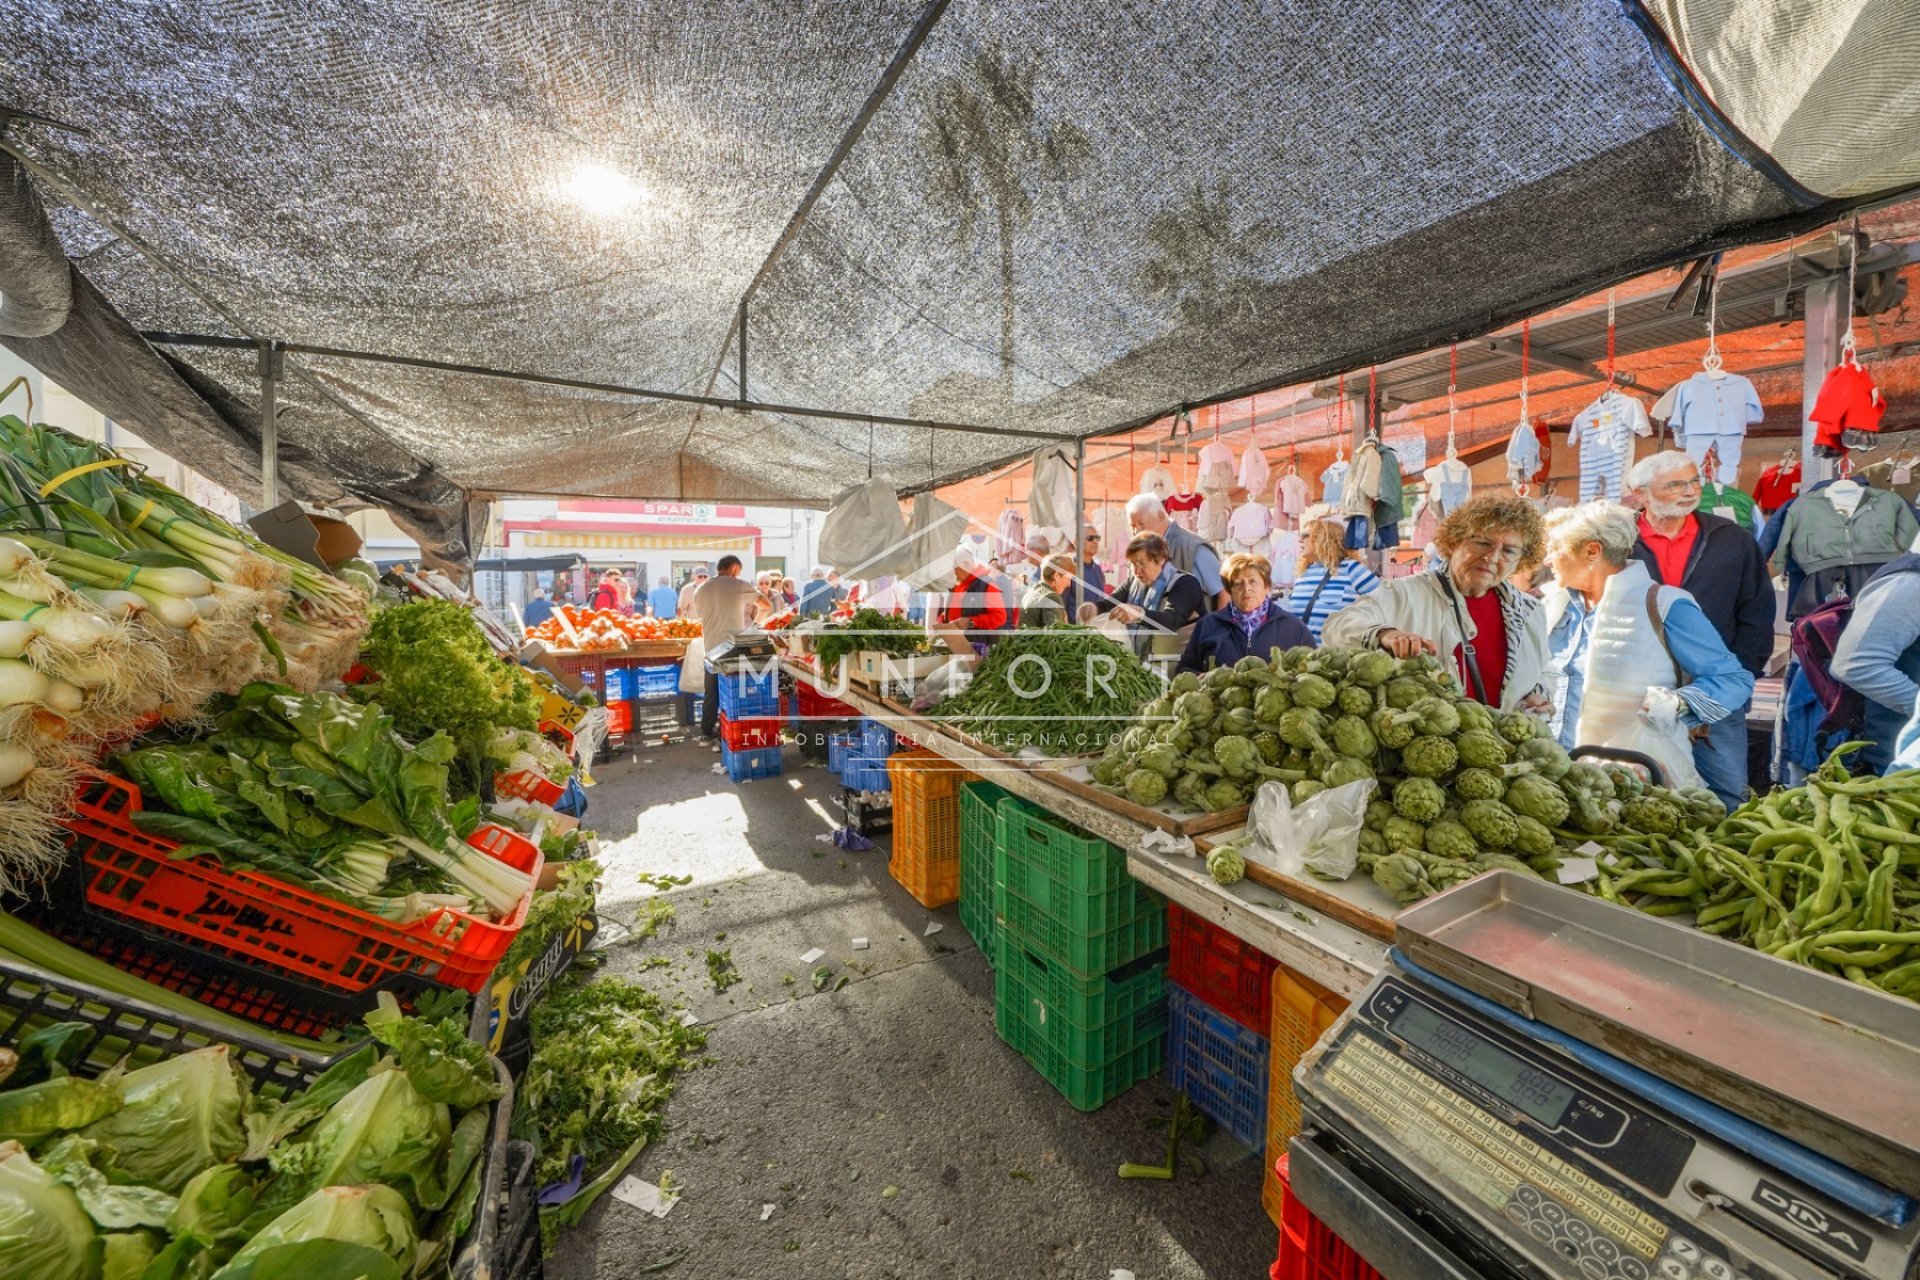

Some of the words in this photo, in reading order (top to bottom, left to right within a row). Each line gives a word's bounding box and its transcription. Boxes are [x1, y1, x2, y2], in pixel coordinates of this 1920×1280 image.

[643, 504, 692, 515] SPAR
[1357, 1095, 1371, 1108] 420
[1373, 1106, 1388, 1119] 430
[1352, 1070, 1366, 1082] 310
[1366, 1081, 1381, 1094] 320
[1383, 1092, 1398, 1105] 330
[1419, 1117, 1434, 1129] 350
[1455, 1141, 1473, 1157] 370
[1476, 1155, 1494, 1171] 380
[1496, 1171, 1515, 1187] 390
[1373, 1046, 1384, 1056] 65
[1389, 1056, 1399, 1065] 75
[1405, 1067, 1417, 1076] 85
[1441, 1088, 1453, 1099] 50
[1459, 1100, 1472, 1111] 60
[1479, 1113, 1492, 1124] 70
[1499, 1126, 1513, 1137] 80
[1521, 1140, 1534, 1151] 90
[1565, 1168, 1584, 1183] 110
[1589, 1183, 1610, 1199] 120
[1615, 1200, 1636, 1217] 130
[1643, 1217, 1664, 1235] 140
[1446, 1115, 1463, 1128] 210
[1466, 1127, 1483, 1140] 220
[1486, 1140, 1504, 1155] 230
[1508, 1155, 1526, 1170] 240
[1530, 1169, 1549, 1185] 250
[1552, 1184, 1573, 1200] 260
[1578, 1200, 1599, 1218] 270
[1604, 1218, 1626, 1236] 280
[1631, 1236, 1654, 1254] 290
[1678, 1243, 1694, 1254] 7
[1667, 1265, 1682, 1276] 4
[1710, 1264, 1725, 1277] 8
